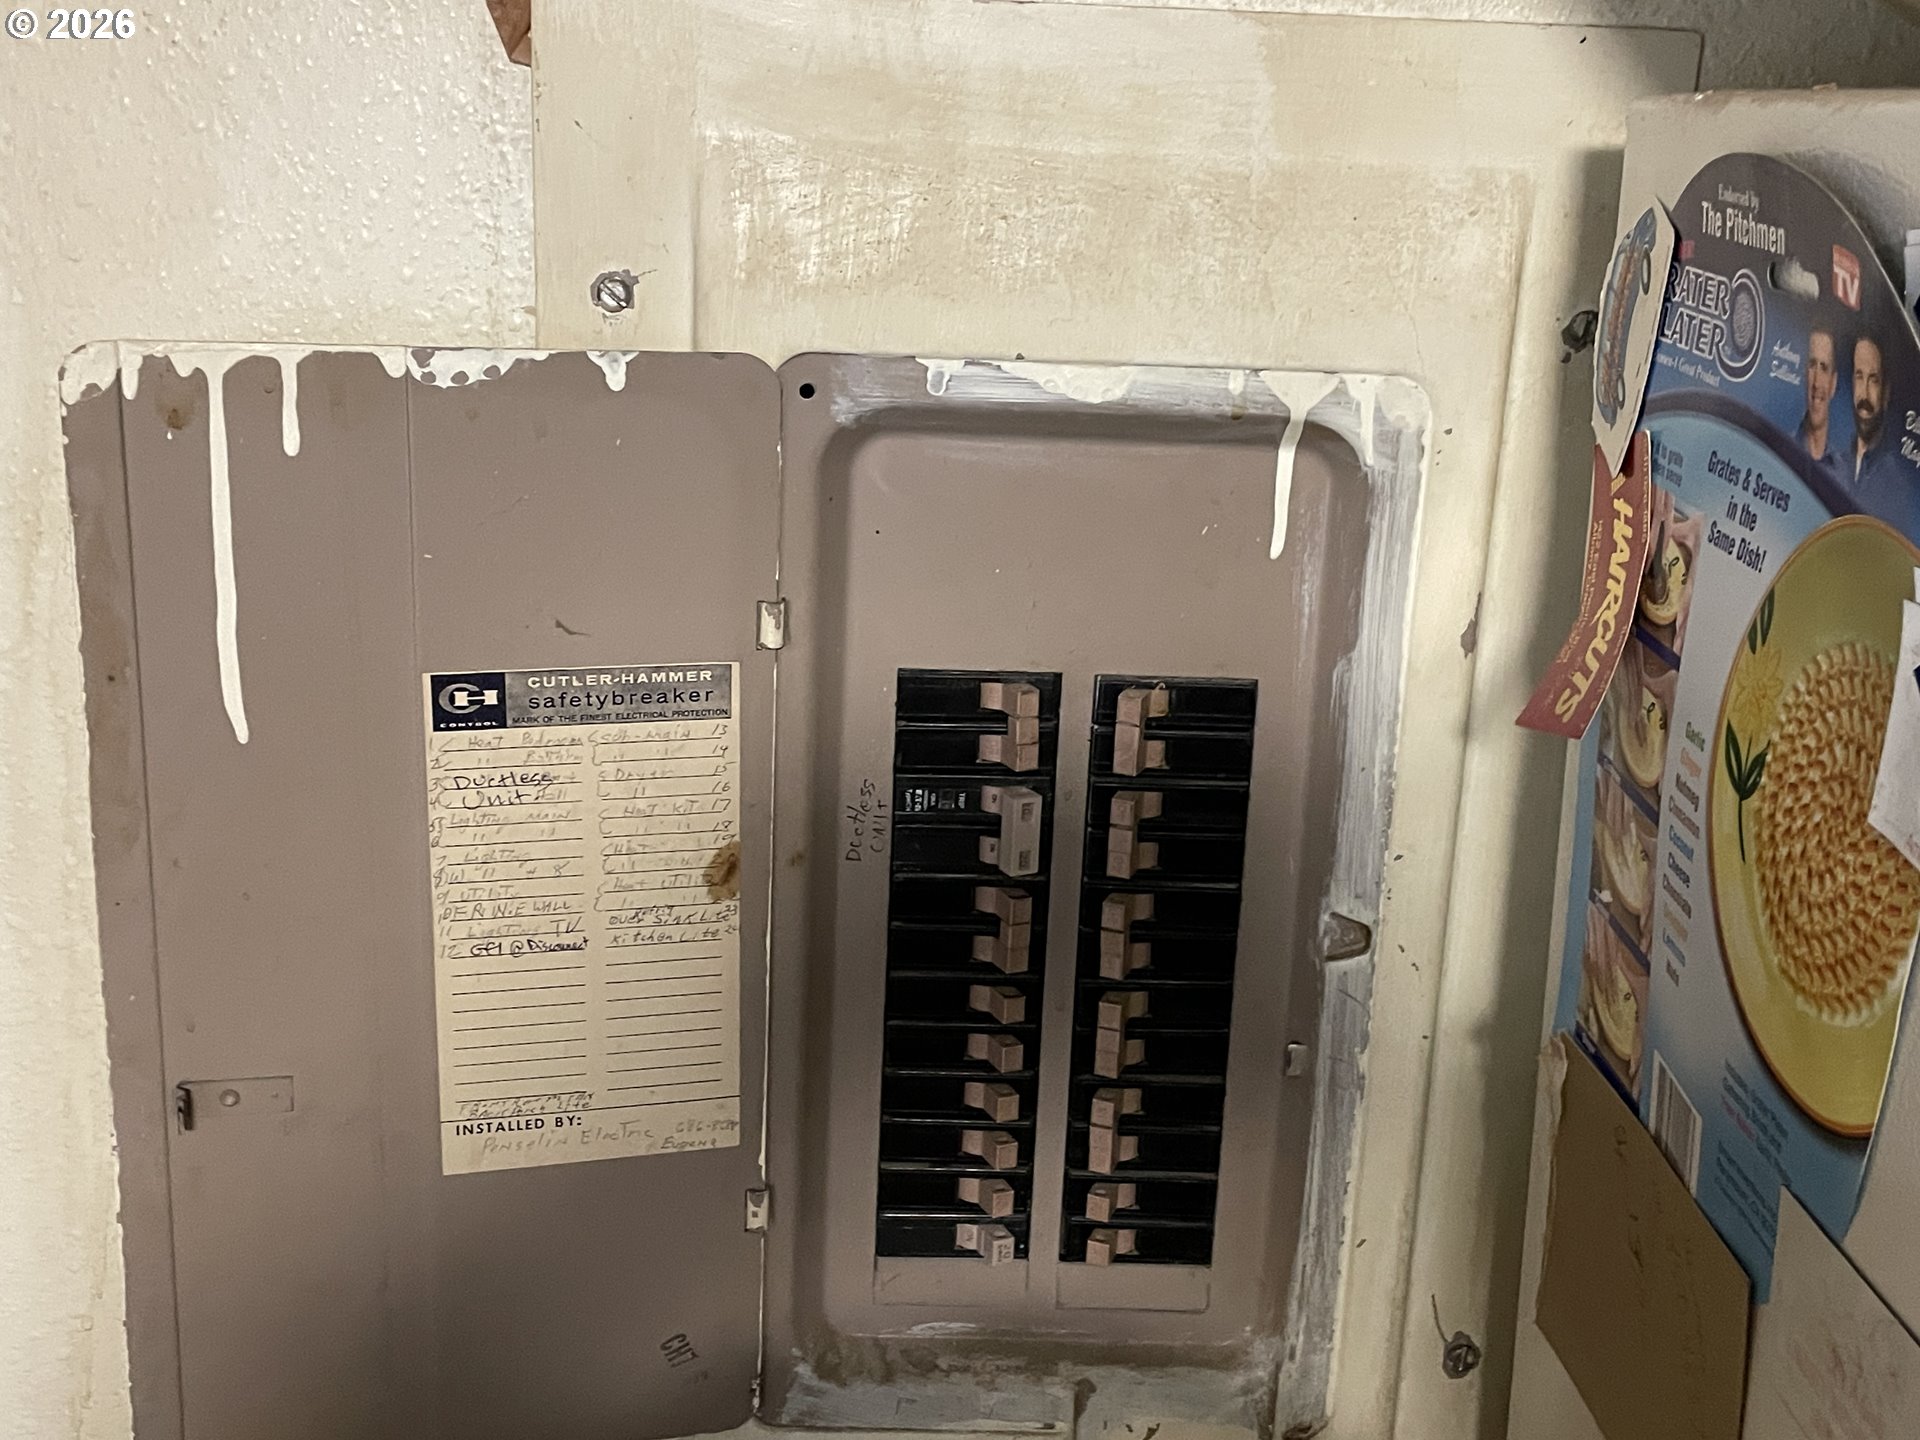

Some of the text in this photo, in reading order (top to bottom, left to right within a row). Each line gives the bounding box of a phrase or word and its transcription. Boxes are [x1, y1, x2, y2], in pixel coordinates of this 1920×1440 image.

[1701, 200, 1722, 237] The
[1726, 207, 1785, 255] Pitchmen
[1666, 261, 1731, 319] RATER
[1834, 262, 1860, 306] TV
[1659, 302, 1728, 361] LATER
[1707, 450, 1740, 487] Grates
[1741, 470, 1751, 493] &
[1752, 472, 1791, 513] Serves
[1725, 495, 1758, 532] in the
[1707, 520, 1767, 574] Same Dish!
[1555, 497, 1634, 724] HAIRCUTS
[527, 670, 713, 689] CUTLER-HAMMER
[528, 688, 715, 710] safetybreaker
[439, 720, 499, 729] CONTROL
[511, 708, 729, 725] MARK OF THE FINEST ELECTRICAL PROTECTION
[711, 723, 729, 737] 13
[453, 771, 553, 791] Ductless
[462, 791, 539, 810] Unit
[455, 1115, 583, 1136] INSTALLED BY:
